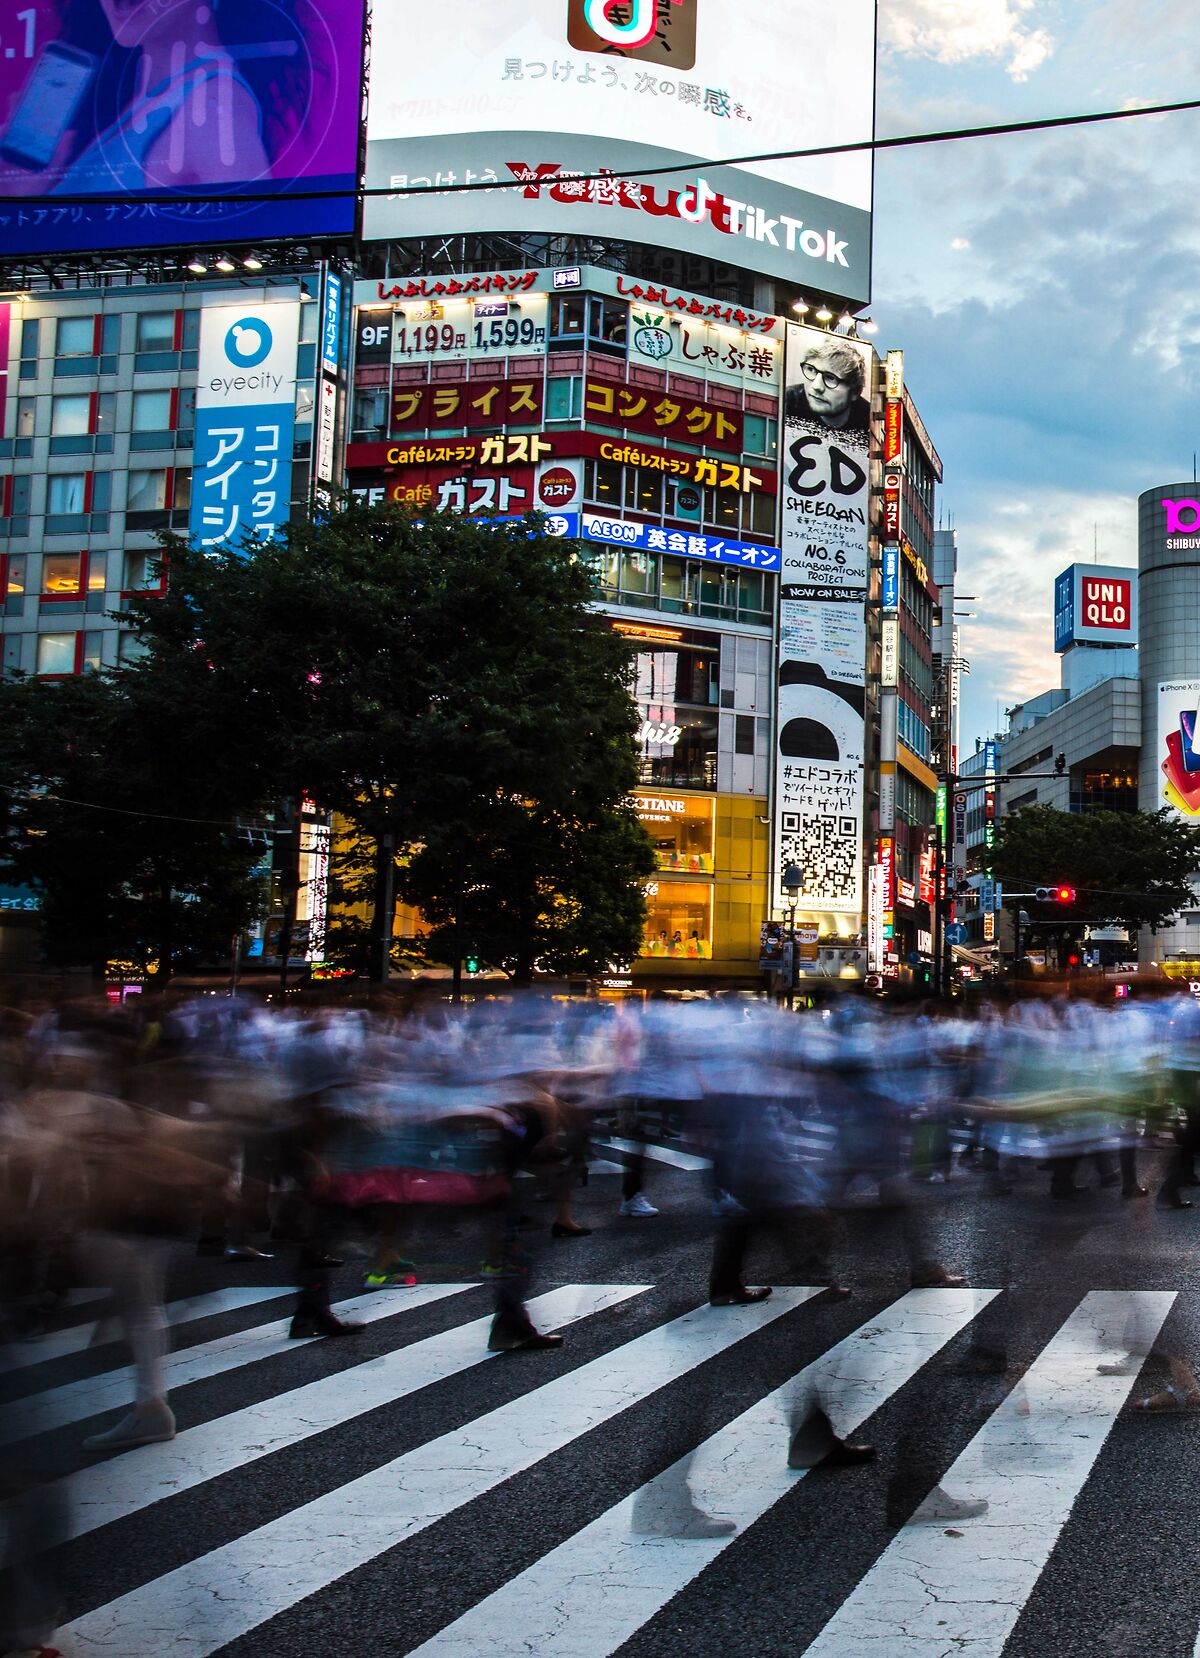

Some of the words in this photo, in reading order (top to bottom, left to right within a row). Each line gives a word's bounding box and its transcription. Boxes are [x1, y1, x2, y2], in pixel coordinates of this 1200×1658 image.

[721, 200, 850, 268] TikTok
[377, 271, 539, 300] しゃぶしゃぶバイキング
[616, 275, 777, 333] しゃぶしゃぶバイキング
[361, 326, 390, 346] 9F
[398, 324, 466, 359] 1,199円
[473, 318, 546, 352] 1,599円
[681, 329, 775, 378] しゃぶ葉
[210, 372, 283, 396] eyecity
[393, 383, 539, 421] プライス
[586, 382, 738, 439] コンタクト
[386, 445, 476, 465] Caféレストラン
[480, 434, 552, 464] ガスト
[600, 444, 690, 476] Caféレストラン
[694, 458, 763, 493] ガスト
[787, 435, 867, 496] ED
[436, 477, 526, 515] ガスト
[543, 484, 573, 497] ガスト
[786, 496, 866, 526] SHEERAN
[588, 520, 637, 543] AEON
[646, 527, 778, 567] 英会話イーオン
[784, 557, 866, 578] COLLABORATIONS
[807, 570, 845, 585] PROJECT
[789, 587, 816, 598] NOW
[817, 589, 833, 599] ON
[834, 588, 859, 599] SALE
[1087, 583, 1122, 603] UNI
[1087, 604, 1126, 625] QLO
[1165, 683, 1187, 691] iPhone
[783, 764, 858, 784] #エドコラボ
[782, 793, 814, 806] カードを
[818, 797, 852, 812] ゲット!
[783, 782, 858, 797] でツイートしてギフト
